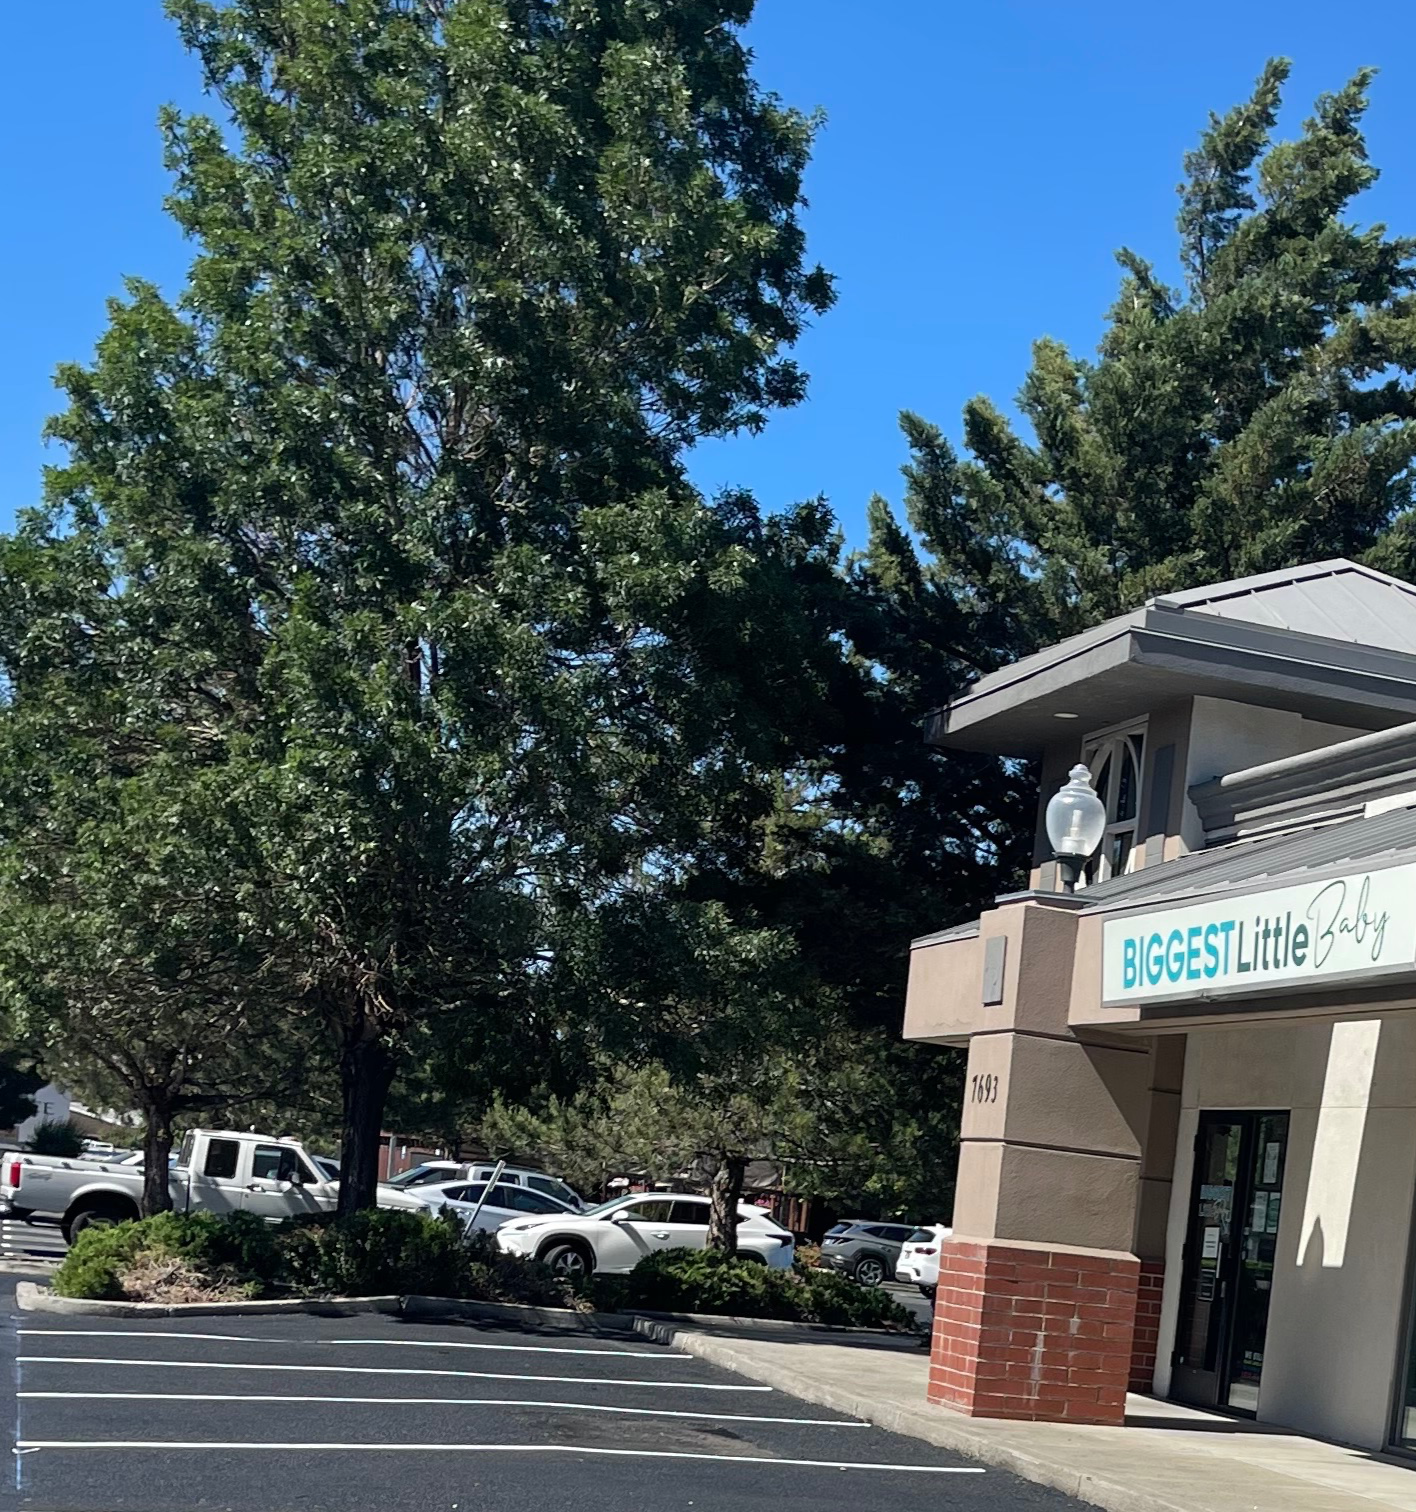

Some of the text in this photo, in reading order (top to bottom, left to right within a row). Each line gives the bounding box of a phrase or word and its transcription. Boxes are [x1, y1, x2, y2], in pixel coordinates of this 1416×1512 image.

[1123, 875, 1390, 989] BIGGEST Little Baby
[971, 1073, 999, 1104] 1693
